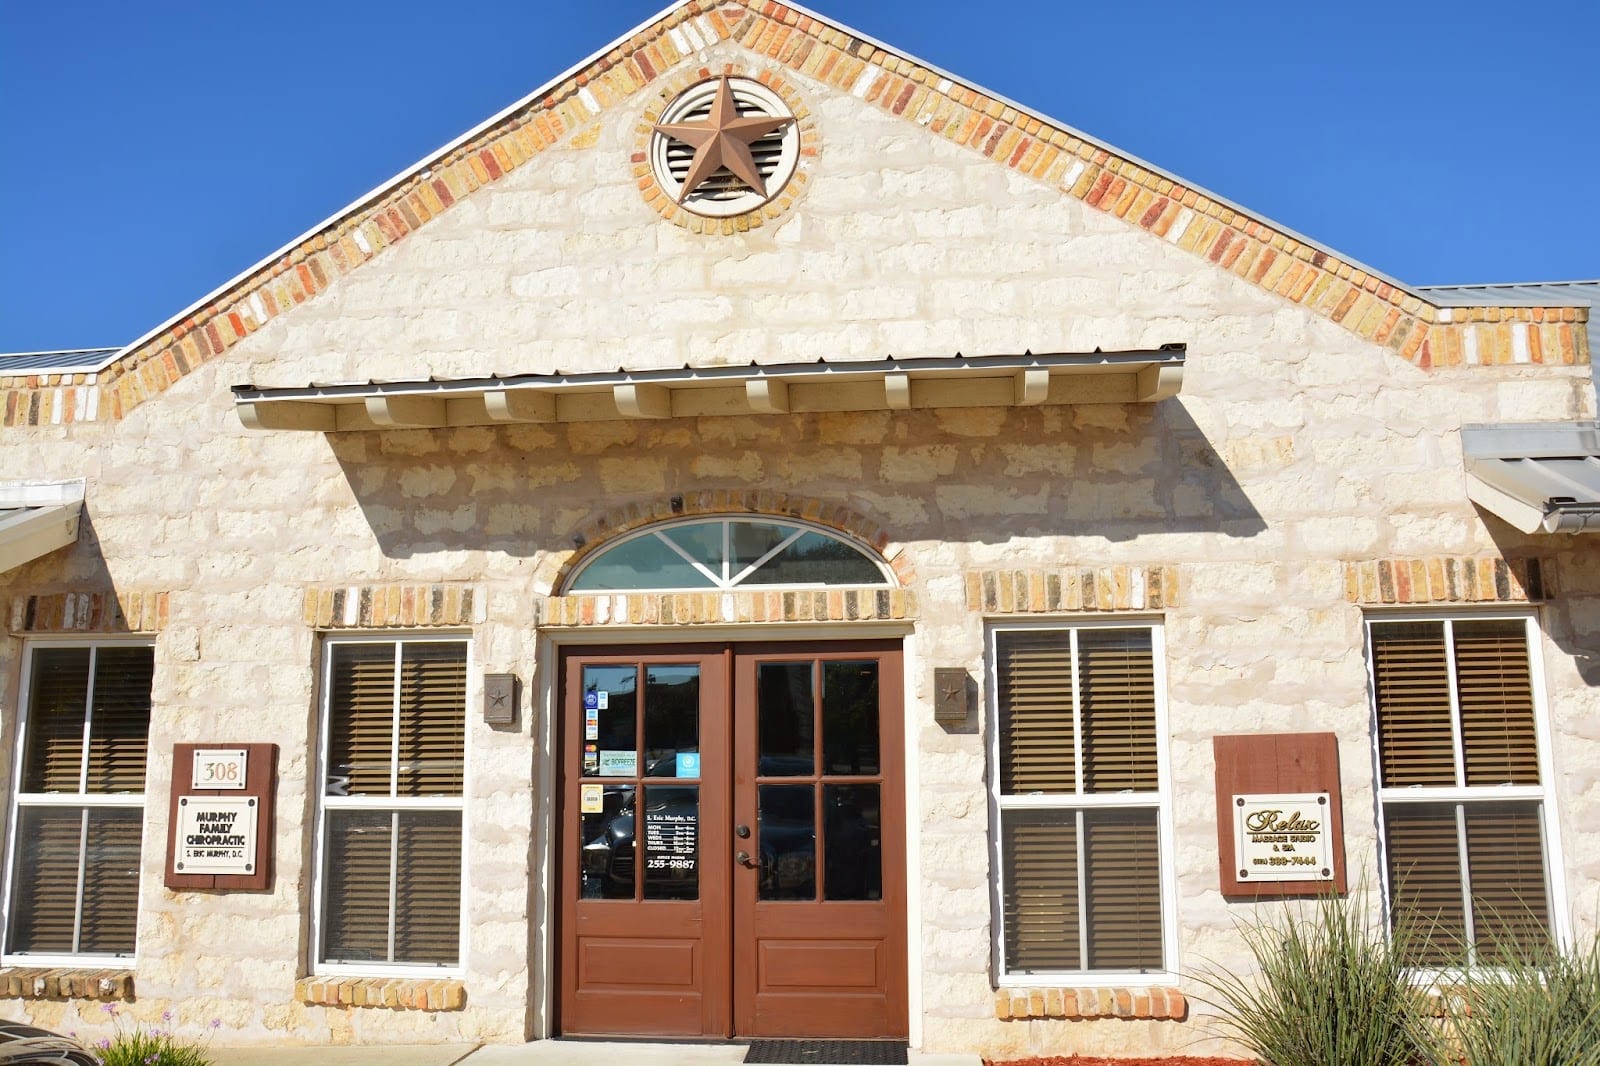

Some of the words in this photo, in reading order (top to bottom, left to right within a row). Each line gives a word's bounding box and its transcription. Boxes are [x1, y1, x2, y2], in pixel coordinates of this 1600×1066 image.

[204, 762, 238, 781] 308
[196, 812, 238, 822] MURPHY
[1246, 810, 1320, 832] Relax
[199, 823, 233, 834] FAMILY
[186, 835, 245, 845] CHIROPRACTIC
[1252, 835, 1288, 843] MASSAGE
[1290, 835, 1316, 843] STUDIO
[1272, 844, 1280, 852] &
[1282, 844, 1296, 852] SPA
[232, 850, 243, 858] D.C.
[647, 860, 695, 869] 255-9887
